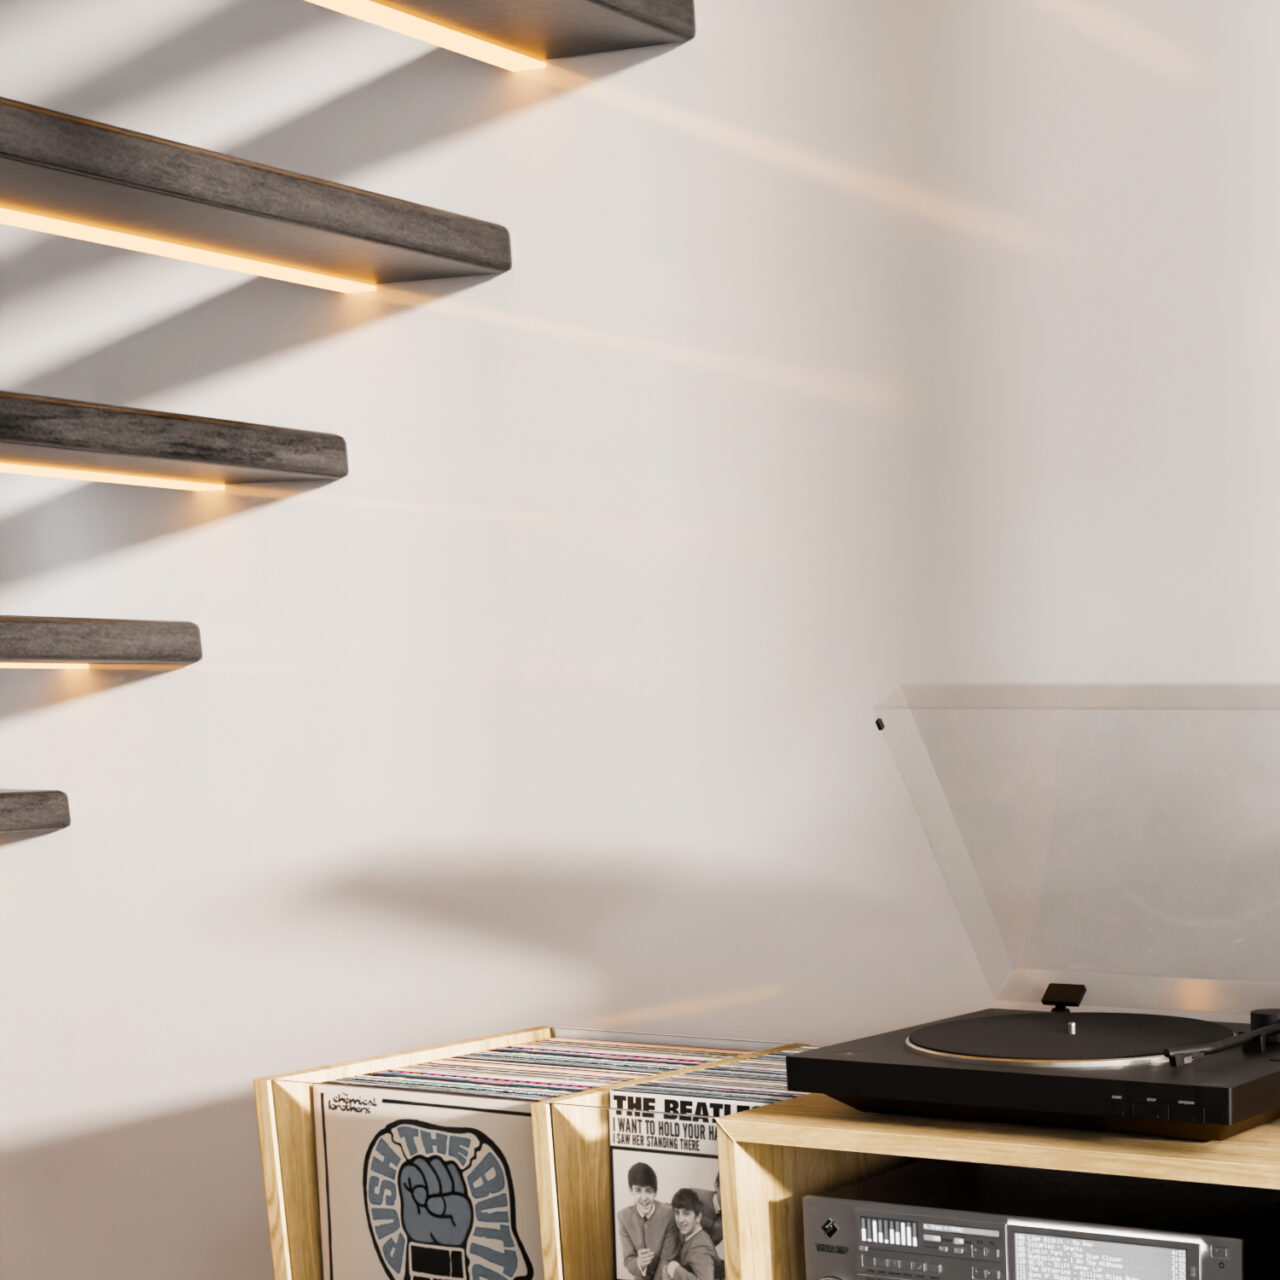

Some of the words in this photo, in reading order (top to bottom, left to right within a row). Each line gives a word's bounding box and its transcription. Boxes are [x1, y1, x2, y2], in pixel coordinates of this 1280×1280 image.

[613, 1094, 656, 1118] THE
[618, 1118, 642, 1134] WANT
[646, 1120, 656, 1135] TO
[658, 1121, 680, 1137] HOLD
[683, 1122, 706, 1140] YOUR
[616, 1134, 630, 1145] SAW
[632, 1135, 645, 1146] HER
[646, 1136, 678, 1150] STANDING
[680, 1139, 700, 1152] THERE
[368, 1138, 406, 1274] PUSH
[397, 1125, 472, 1168] THE
